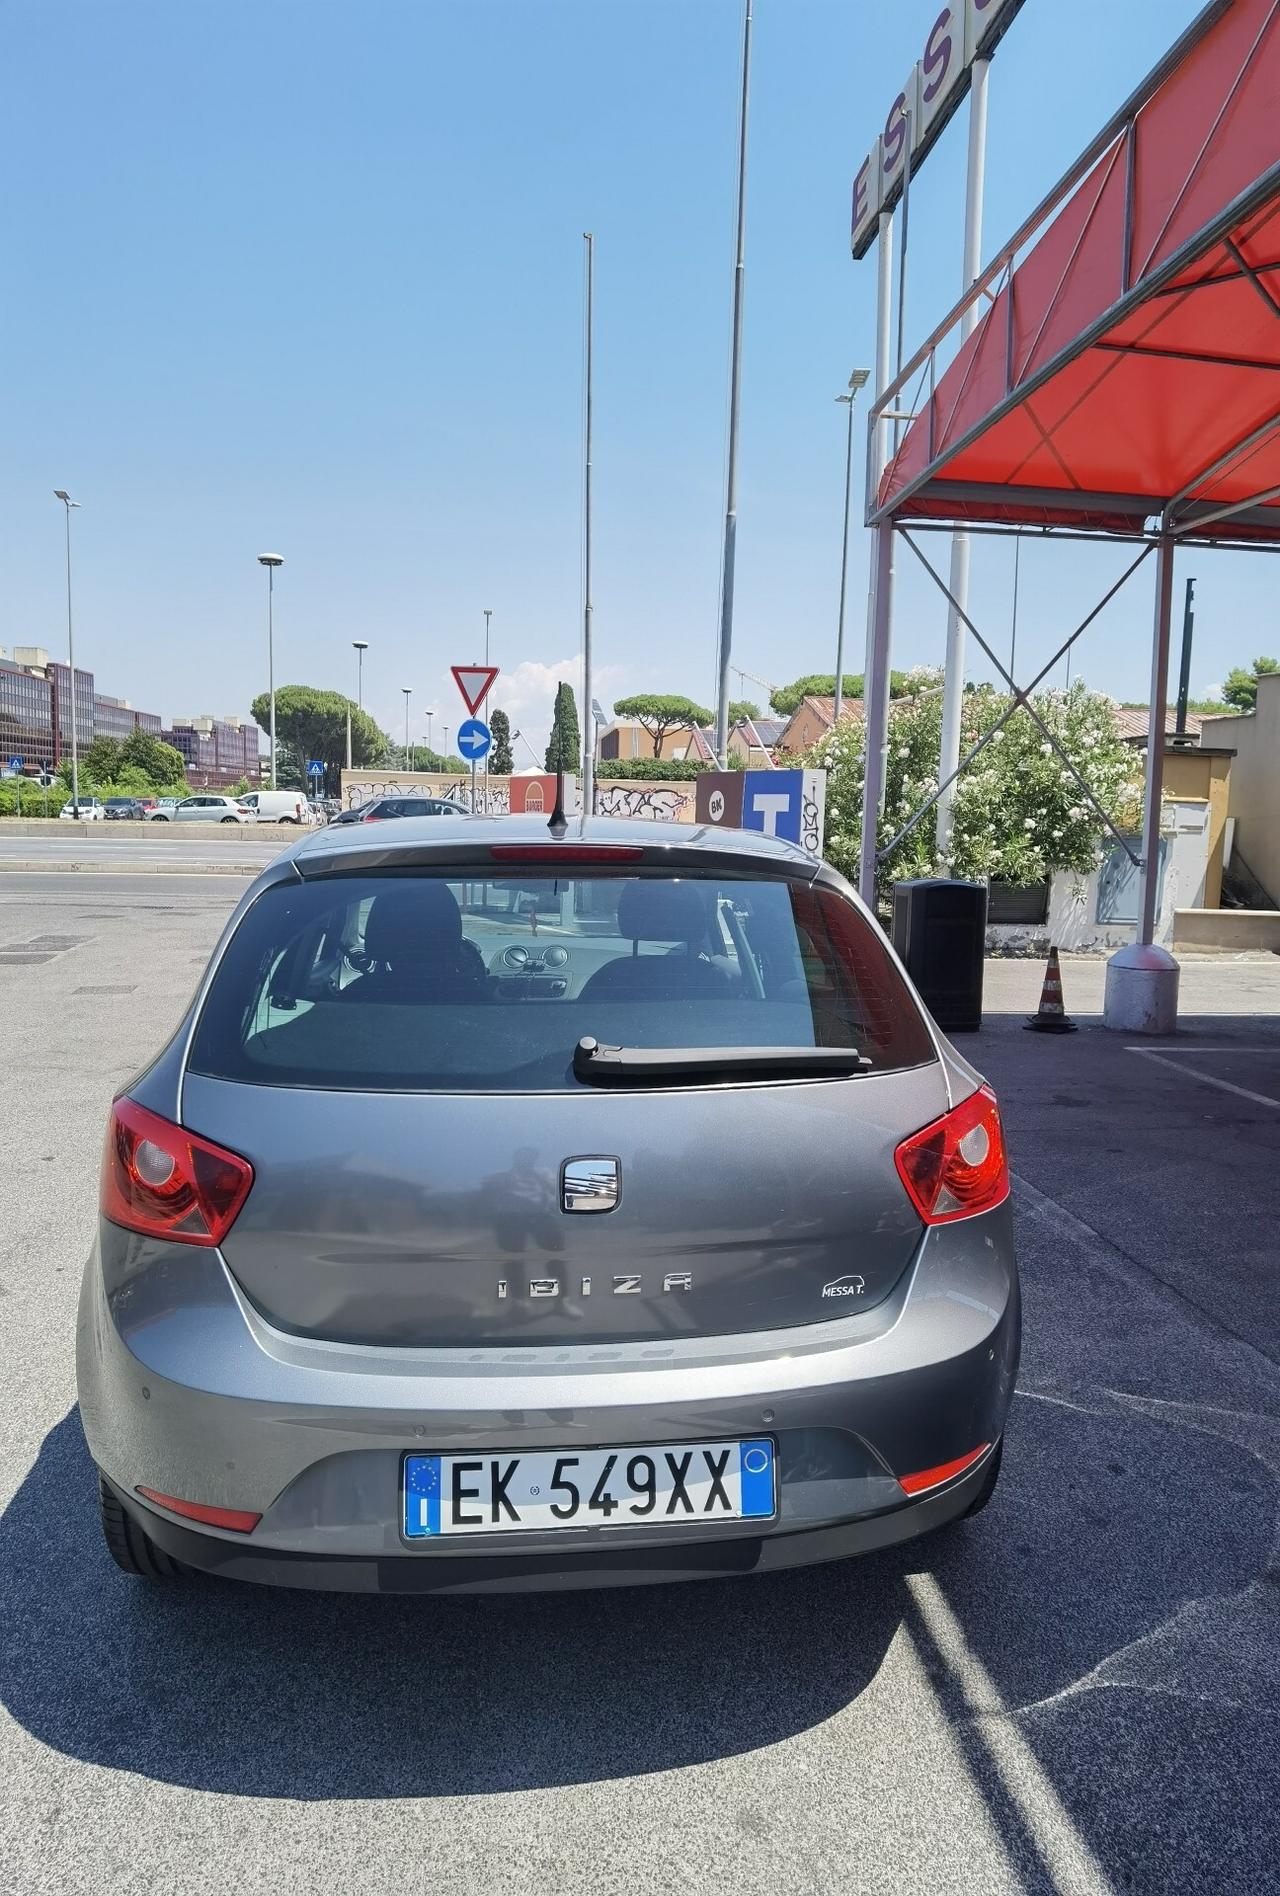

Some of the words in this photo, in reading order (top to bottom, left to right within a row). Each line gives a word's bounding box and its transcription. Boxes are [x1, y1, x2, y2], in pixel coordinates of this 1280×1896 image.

[852, 0, 992, 236] ESS
[711, 797, 723, 814] BK
[498, 1272, 692, 1298] IBIZA
[821, 1285, 854, 1298] MESSA
[452, 1459, 521, 1525] EK
[550, 1449, 733, 1520] 549XX
